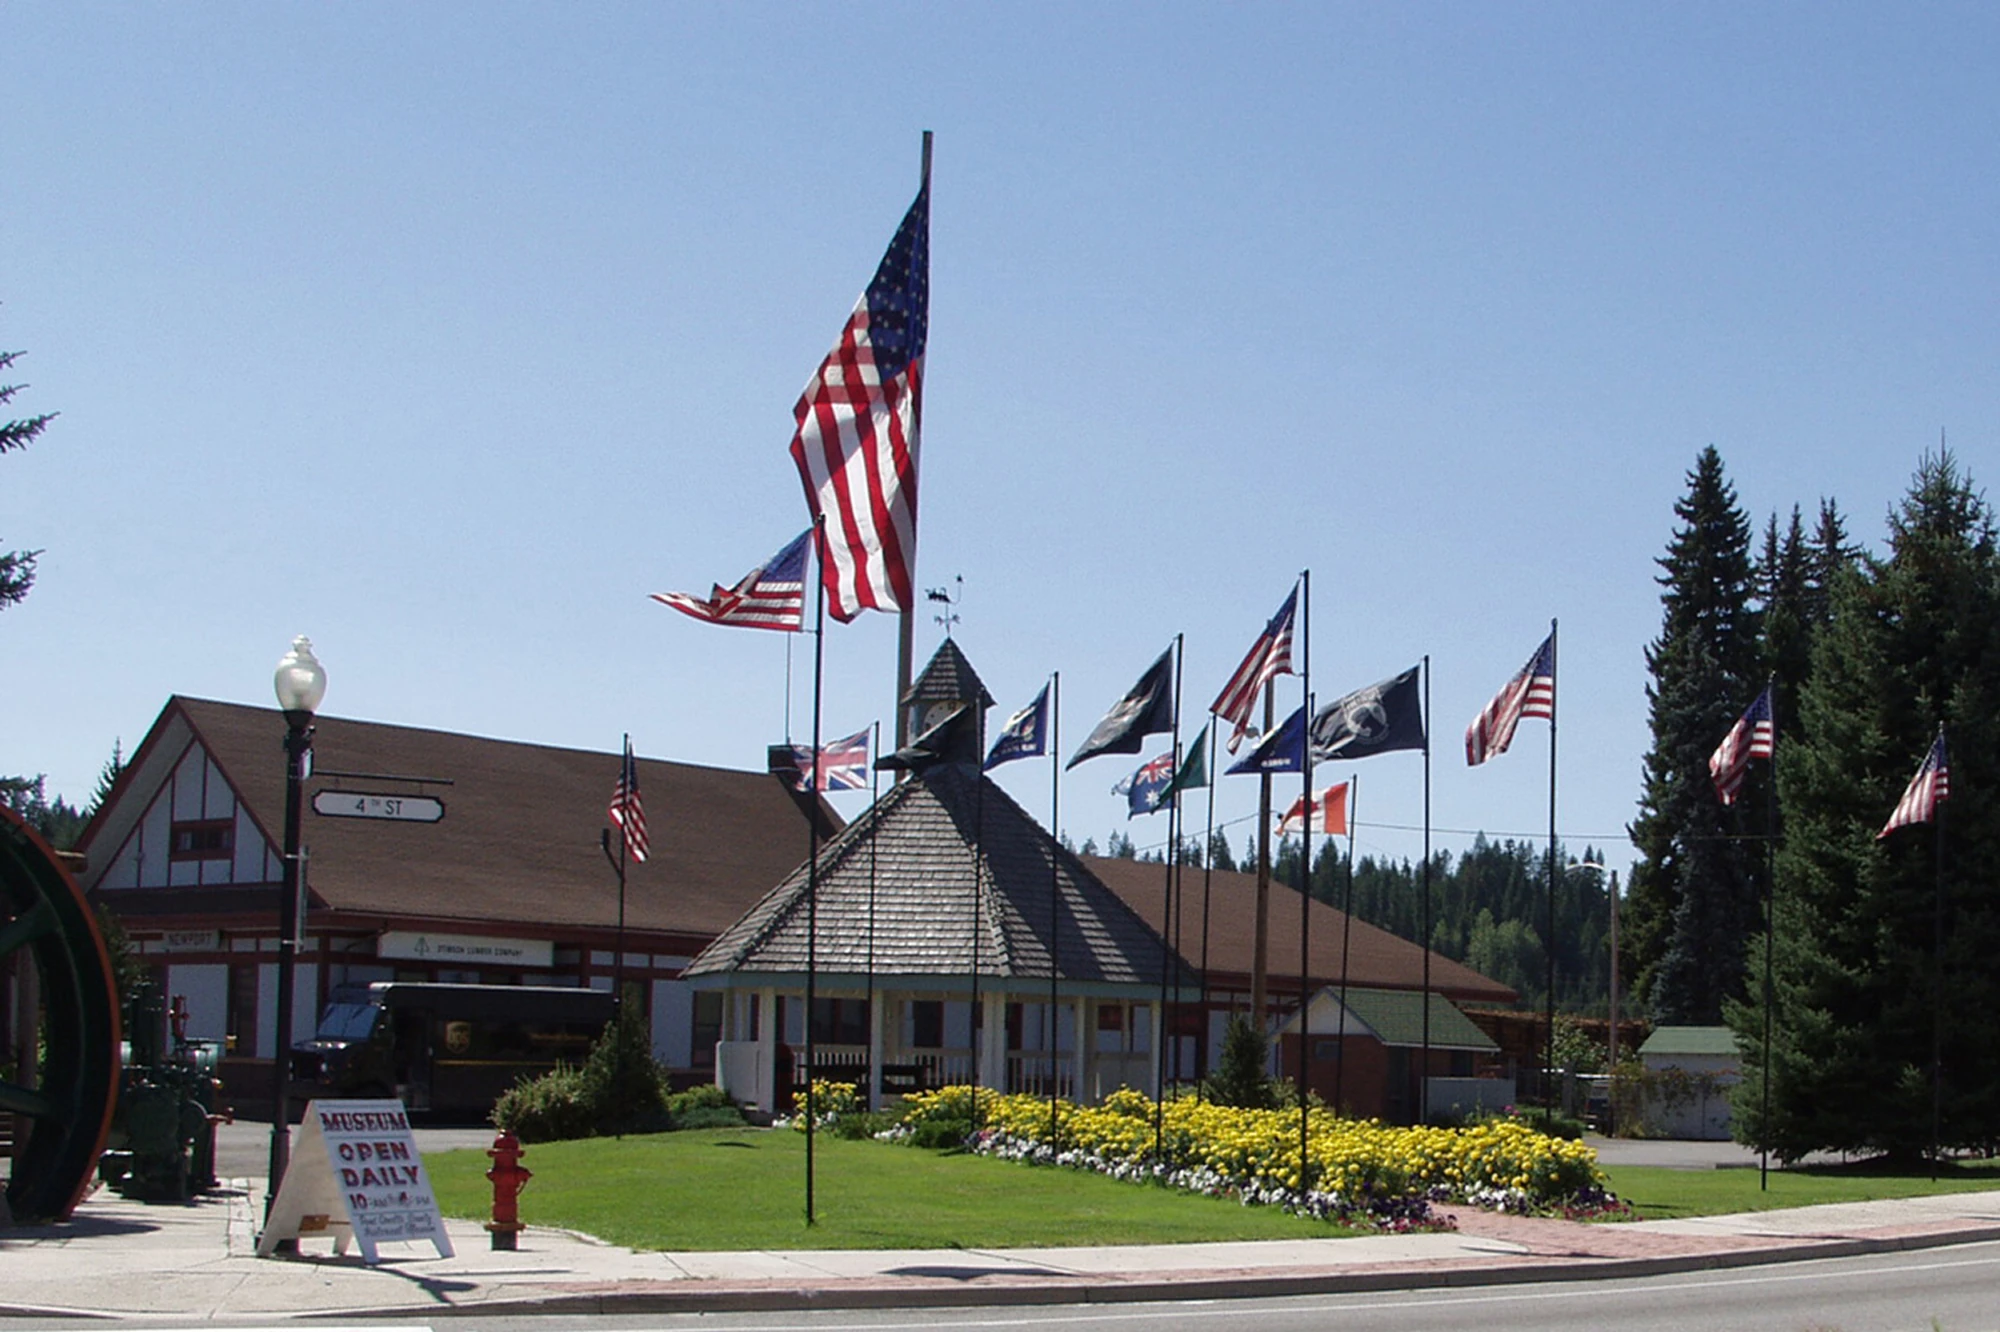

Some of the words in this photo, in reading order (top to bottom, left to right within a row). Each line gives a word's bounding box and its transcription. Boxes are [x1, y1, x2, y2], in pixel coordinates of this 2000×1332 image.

[385, 799, 403, 815] ST
[320, 1112, 408, 1132] MUSEUM
[338, 1142, 411, 1161] OPEN
[341, 1165, 419, 1187] DAILY
[349, 1193, 369, 1209] 10
